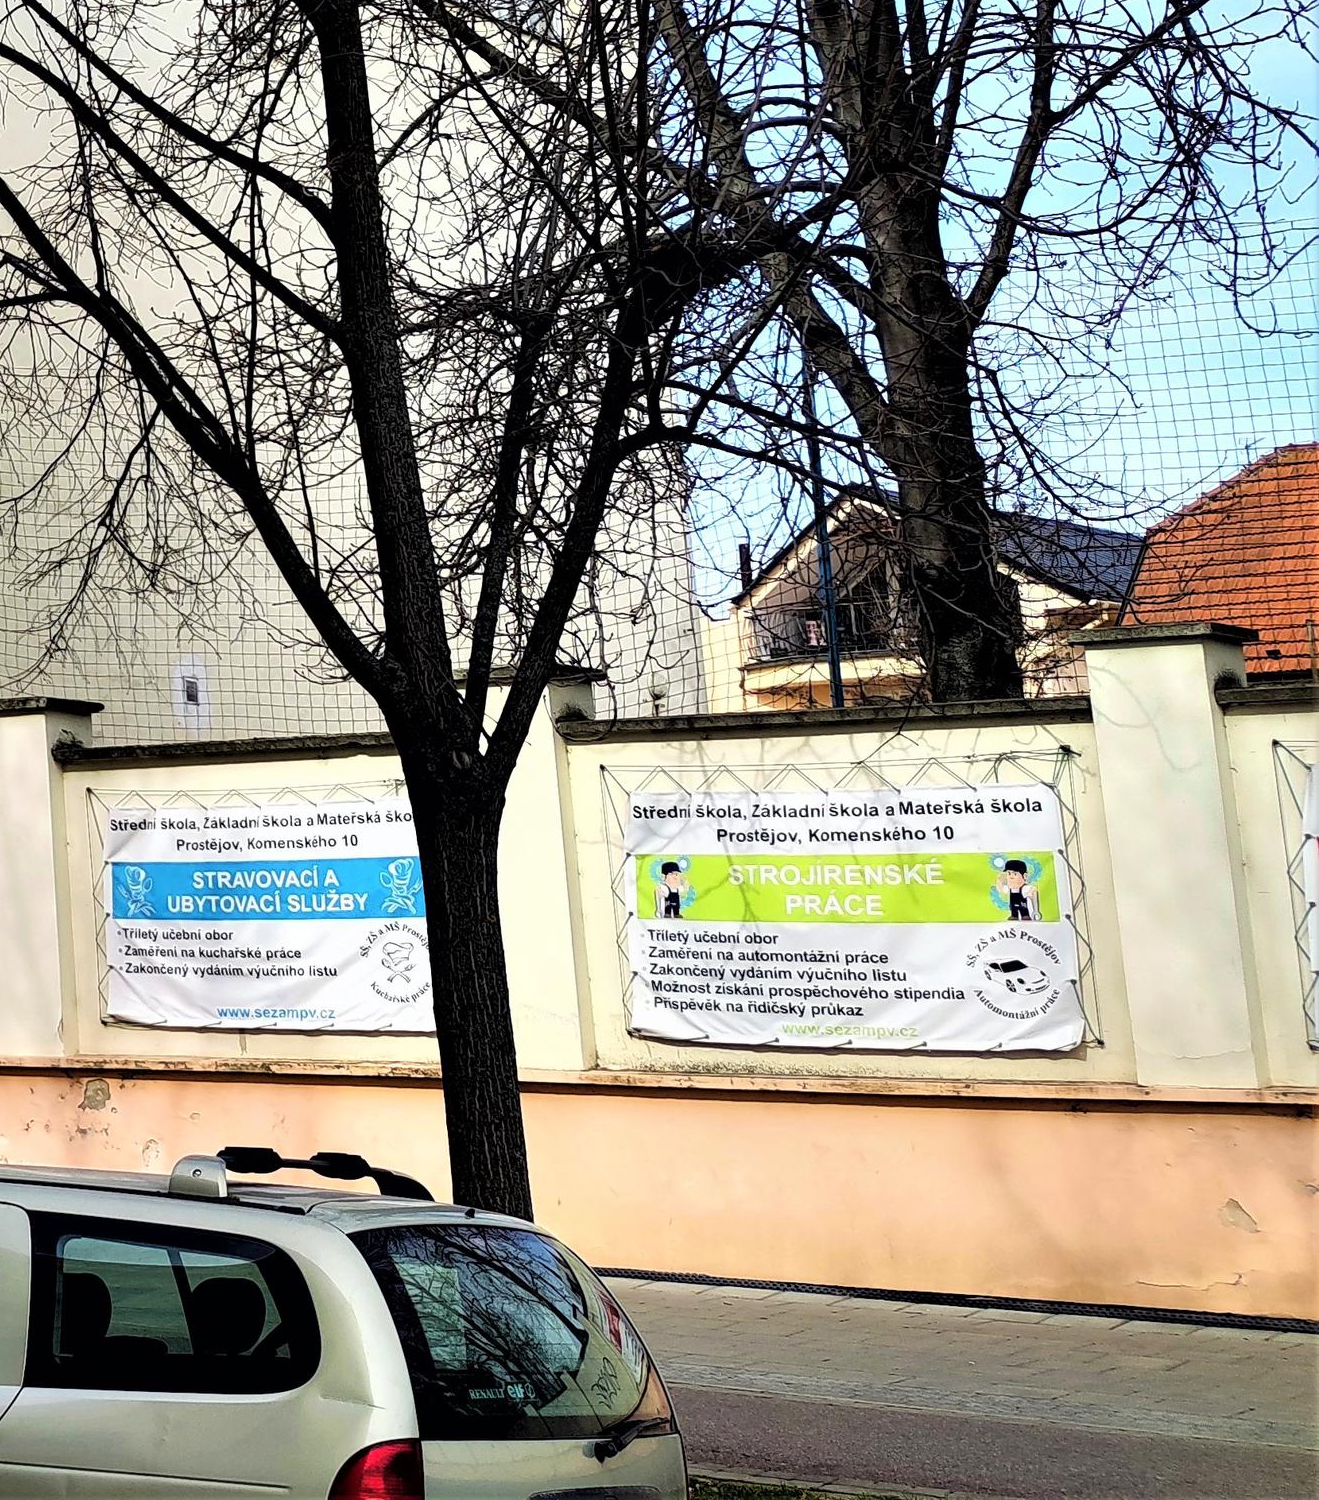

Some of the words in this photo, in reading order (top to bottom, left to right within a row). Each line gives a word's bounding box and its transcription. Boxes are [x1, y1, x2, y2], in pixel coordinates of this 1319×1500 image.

[633, 803, 692, 821] Střední
[696, 802, 748, 822] škola,
[751, 800, 826, 820] Základní
[829, 801, 880, 818] škola
[885, 806, 895, 817] a
[898, 797, 985, 816] Mateřská
[990, 796, 1043, 814] škola
[110, 817, 156, 831] Střední
[160, 817, 200, 832] škola,
[203, 815, 260, 829] Základní
[263, 814, 302, 827] škola
[307, 817, 314, 827] a
[317, 811, 381, 825] Mateřská
[386, 810, 412, 823] ško
[176, 838, 243, 853] Prostějov,
[248, 835, 337, 849] Komenského
[342, 834, 358, 847] 10
[717, 827, 803, 845] Prostějov,
[808, 824, 927, 843] Komenského
[933, 825, 955, 841] 10
[192, 866, 319, 889] STRAVOVACÍ
[323, 869, 339, 887] A
[727, 858, 945, 886] STROJÍRENSKÉ
[167, 890, 281, 913] UBYTOVACÍ
[287, 889, 367, 912] SLUŽBY
[785, 888, 883, 916] PRÁCE
[122, 928, 159, 942] Tříletý
[162, 928, 201, 941] učební
[205, 929, 233, 941] obor
[384, 921, 400, 932] MŠ
[402, 924, 429, 950] Prostějo
[647, 929, 689, 944] Tříletý
[694, 931, 740, 944] učební
[744, 932, 779, 944] obor
[124, 945, 177, 957] Zaměření
[181, 950, 195, 958] na
[199, 947, 262, 959] kuchařské
[266, 948, 301, 961] práce
[649, 946, 712, 960] Zaměření
[717, 950, 733, 961] na
[738, 950, 840, 963] automontážní
[845, 951, 889, 966] práce
[998, 928, 1017, 939] MŠ
[1020, 930, 1061, 965] Prostějov
[125, 963, 189, 977] Zakončený
[192, 964, 244, 978] vydáním
[247, 964, 305, 979] výučního
[309, 965, 337, 977] listu
[650, 963, 726, 980] Zakončený
[730, 966, 792, 981] vydáním
[797, 967, 867, 983] výučního
[872, 969, 907, 982] listu
[411, 982, 430, 1002] práce
[651, 980, 711, 994] Možnost
[715, 983, 764, 996] získání
[769, 985, 889, 1000] prospěchového
[894, 987, 965, 1002] stipendia
[726, 1003, 743, 1013] na
[748, 1001, 806, 1018] řidičský
[811, 1002, 864, 1018] průkaz
[1040, 989, 1060, 1014] práce
[217, 1007, 336, 1020] www.sezampv.cz
[782, 1024, 919, 1039] www.sezampv.cz
[469, 1388, 505, 1399] RENAULT
[507, 1383, 524, 1398] elf
